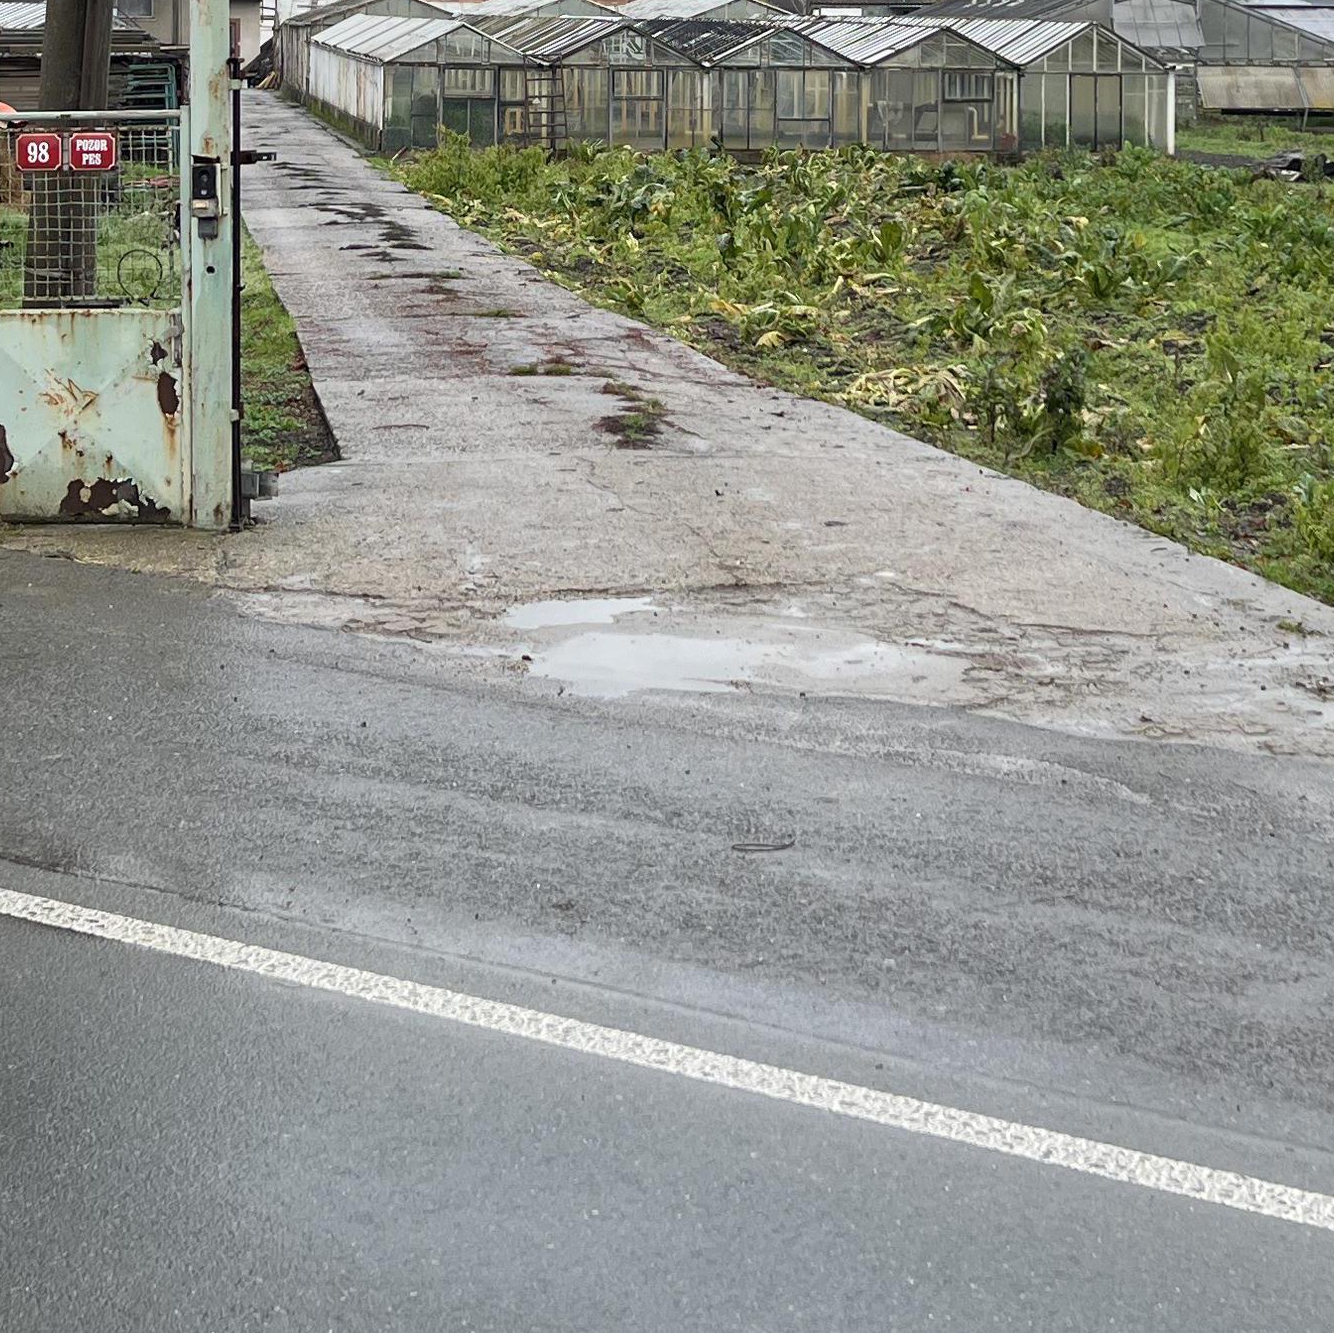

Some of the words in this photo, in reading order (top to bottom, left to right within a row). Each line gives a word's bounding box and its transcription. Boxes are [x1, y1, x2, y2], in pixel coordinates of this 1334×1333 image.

[75, 139, 108, 152] POZOR
[27, 141, 50, 164] 98
[81, 153, 102, 166] PES
